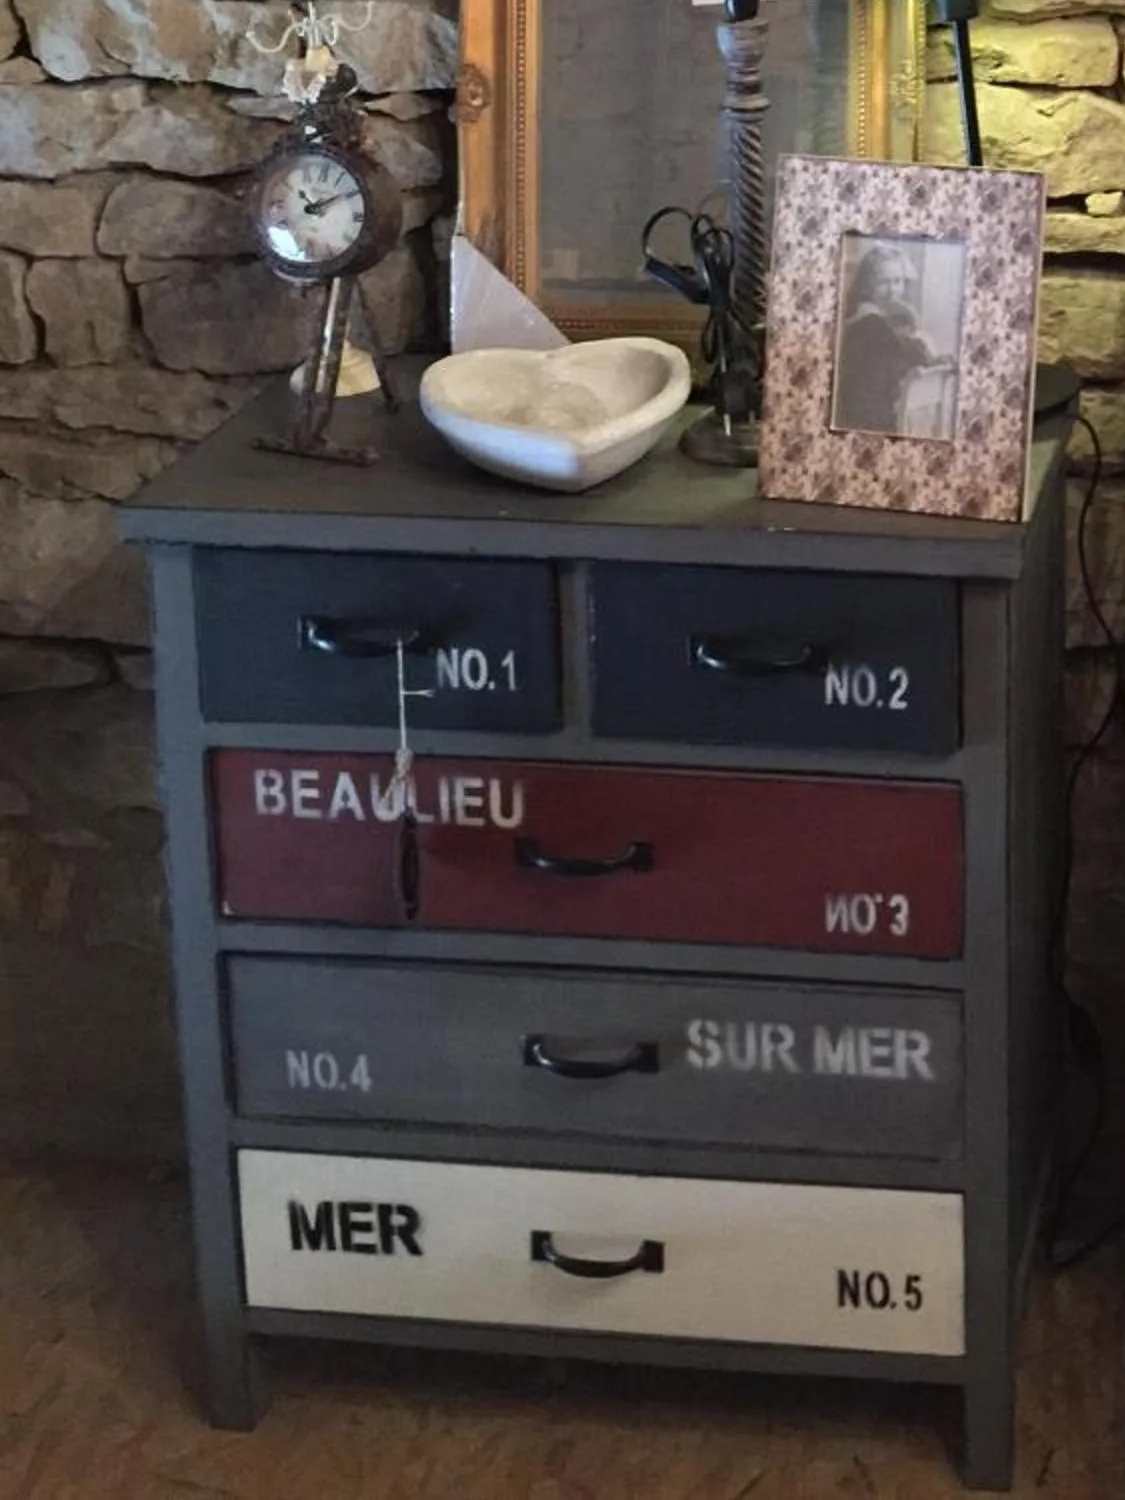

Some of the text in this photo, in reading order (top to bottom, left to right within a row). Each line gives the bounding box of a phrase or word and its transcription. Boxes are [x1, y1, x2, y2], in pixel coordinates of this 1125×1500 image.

[436, 647, 517, 692] NO.1
[825, 663, 910, 710] NO.2
[254, 767, 526, 829] BEAULIEU
[286, 1049, 373, 1093] NO.4
[685, 1018, 937, 1081] SUR MER
[287, 1198, 425, 1257] MER
